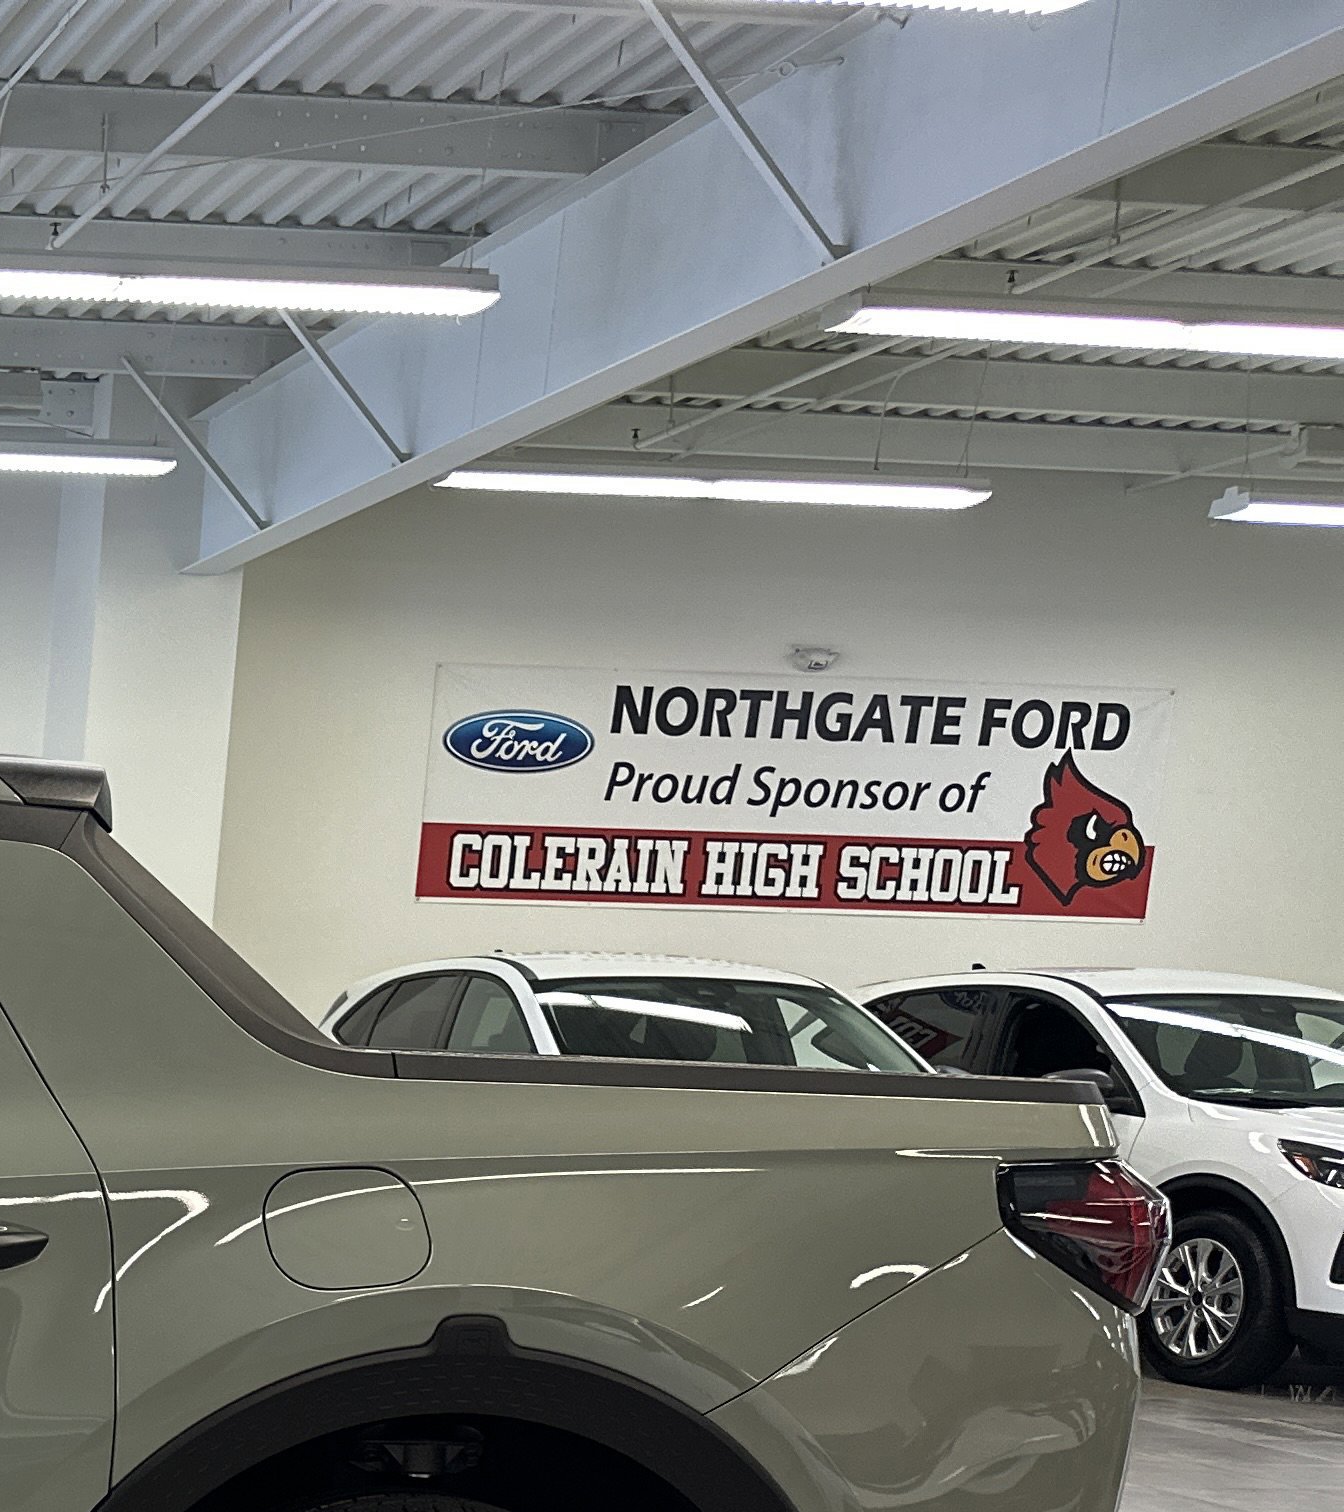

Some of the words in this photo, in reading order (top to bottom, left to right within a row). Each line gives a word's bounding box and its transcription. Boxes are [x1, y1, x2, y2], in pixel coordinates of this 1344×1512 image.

[470, 718, 567, 763] Ford
[610, 684, 967, 747] NORTHGATE
[977, 697, 1131, 751] FORD
[604, 761, 742, 805] Proud
[746, 764, 932, 818] Sponsor
[938, 771, 991, 814] of
[447, 831, 690, 896] COLERAIN
[700, 840, 825, 899] HIGH
[835, 844, 1021, 906] SCHOOL
